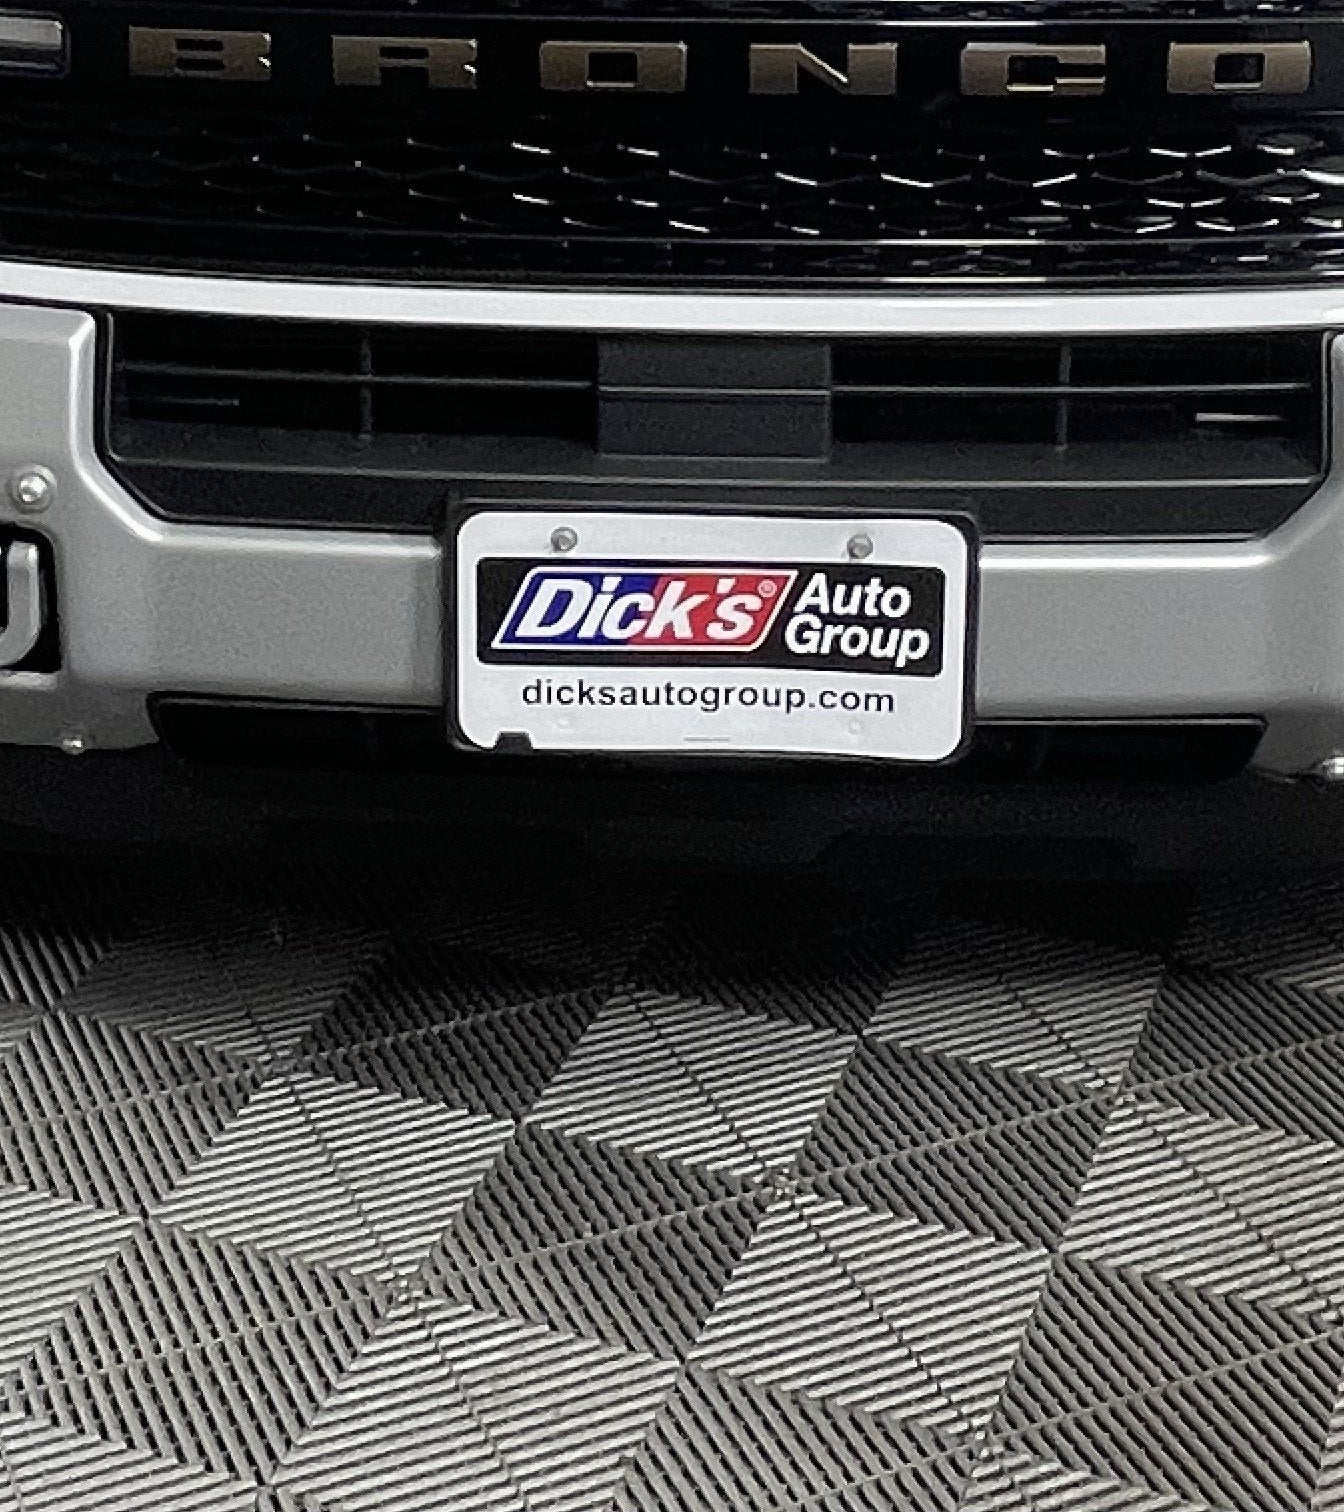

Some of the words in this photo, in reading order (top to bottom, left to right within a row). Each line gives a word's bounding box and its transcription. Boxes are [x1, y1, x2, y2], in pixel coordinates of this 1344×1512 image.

[128, 25, 1311, 95] BRONCO
[515, 574, 757, 641] Dick's
[792, 572, 912, 618] Auto
[784, 614, 930, 668] Group
[522, 678, 895, 714] dicksautogroup.com
